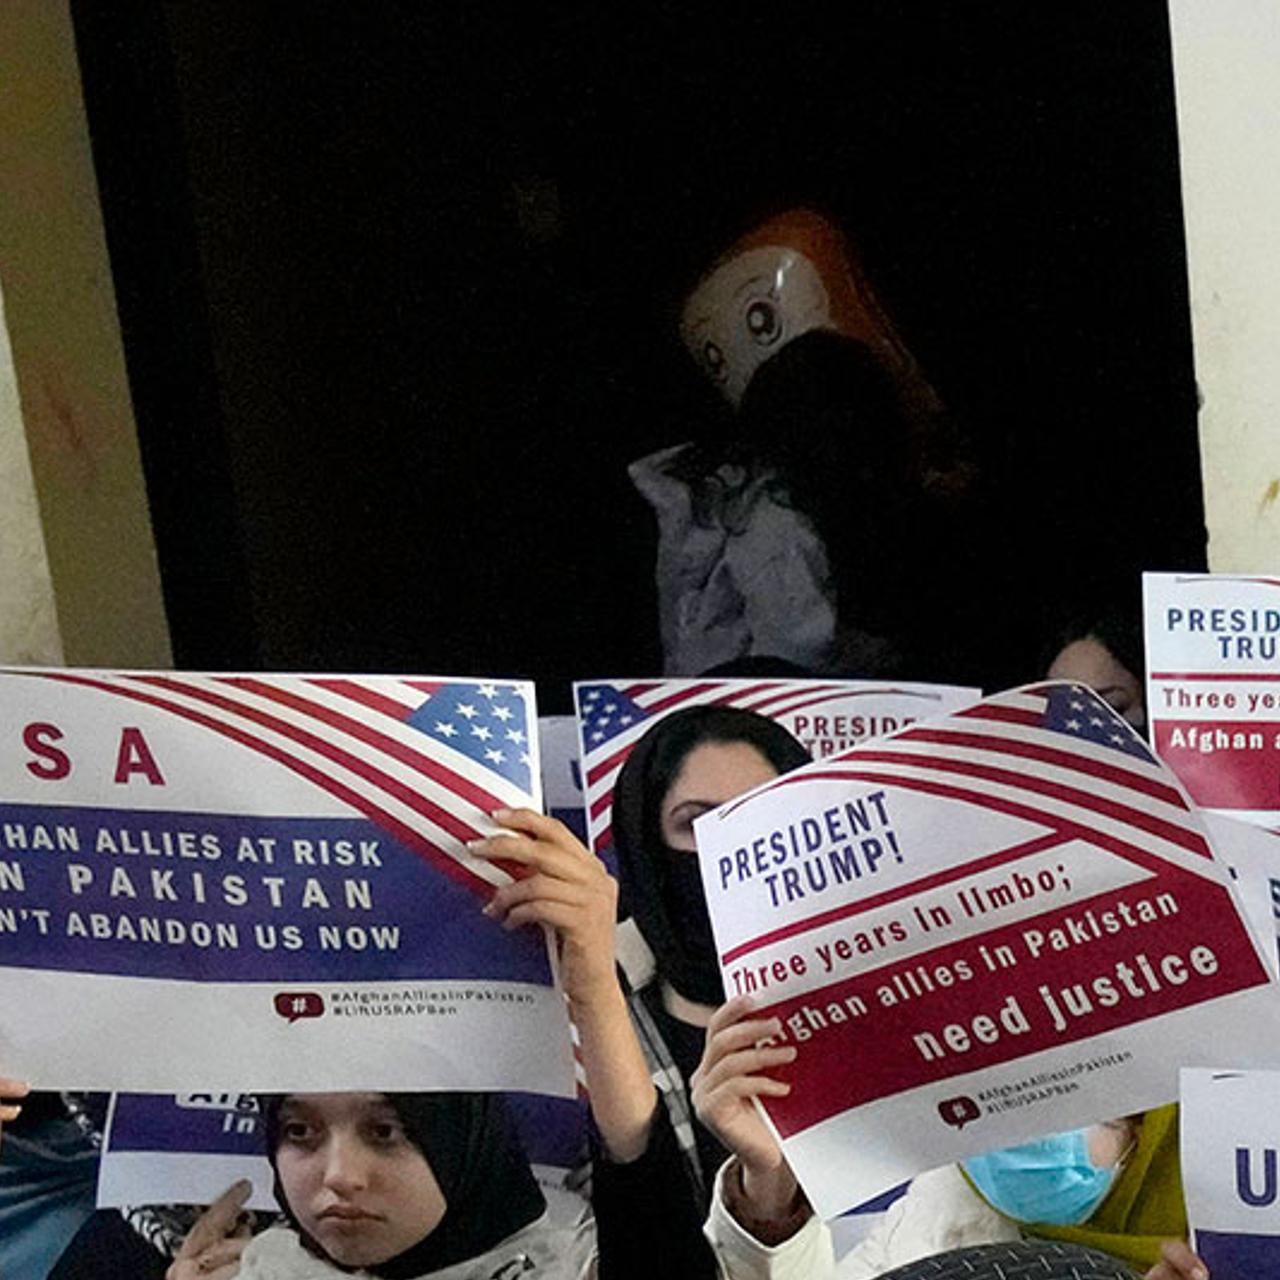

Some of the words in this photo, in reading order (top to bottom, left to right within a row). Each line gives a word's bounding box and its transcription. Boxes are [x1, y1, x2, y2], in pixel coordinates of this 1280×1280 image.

[1163, 688, 1236, 708] Three
[1170, 728, 1262, 753] Afghan
[96, 829, 222, 859] ALLIES
[293, 839, 382, 867] RISK
[717, 791, 891, 890] PRESIDENT
[68, 862, 373, 909] PAKISTAN
[765, 831, 904, 908] TRUMP!
[66, 911, 239, 949] ABANDON
[255, 924, 303, 950] US
[319, 925, 400, 950] NOW
[733, 955, 807, 994] Three
[816, 921, 907, 971] years
[914, 1001, 1029, 1062] need
[1042, 944, 1218, 1031] justice
